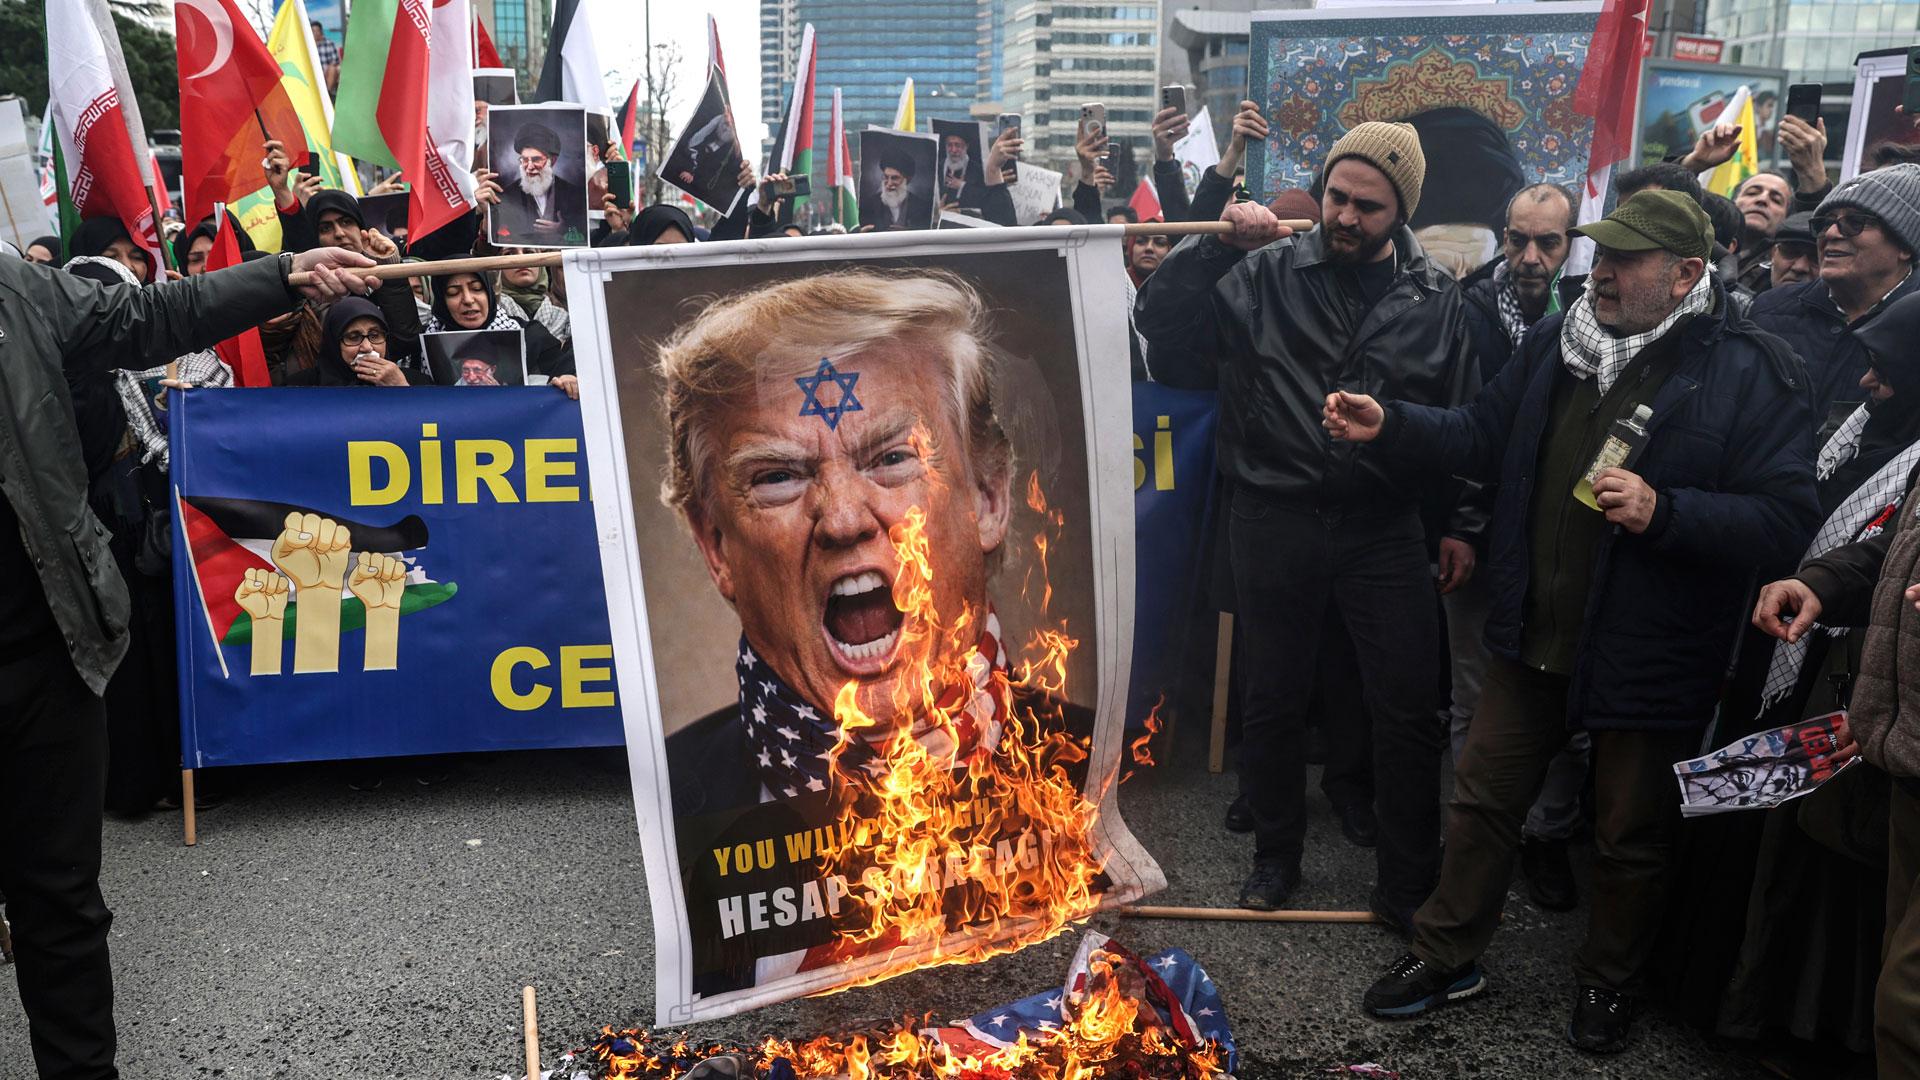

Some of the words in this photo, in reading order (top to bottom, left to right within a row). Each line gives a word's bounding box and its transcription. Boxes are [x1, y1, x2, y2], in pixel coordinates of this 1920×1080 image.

[348, 423, 593, 507] DİRE
[712, 837, 776, 878] YOU
[784, 821, 850, 865] WILL
[717, 874, 848, 941] HESAP
